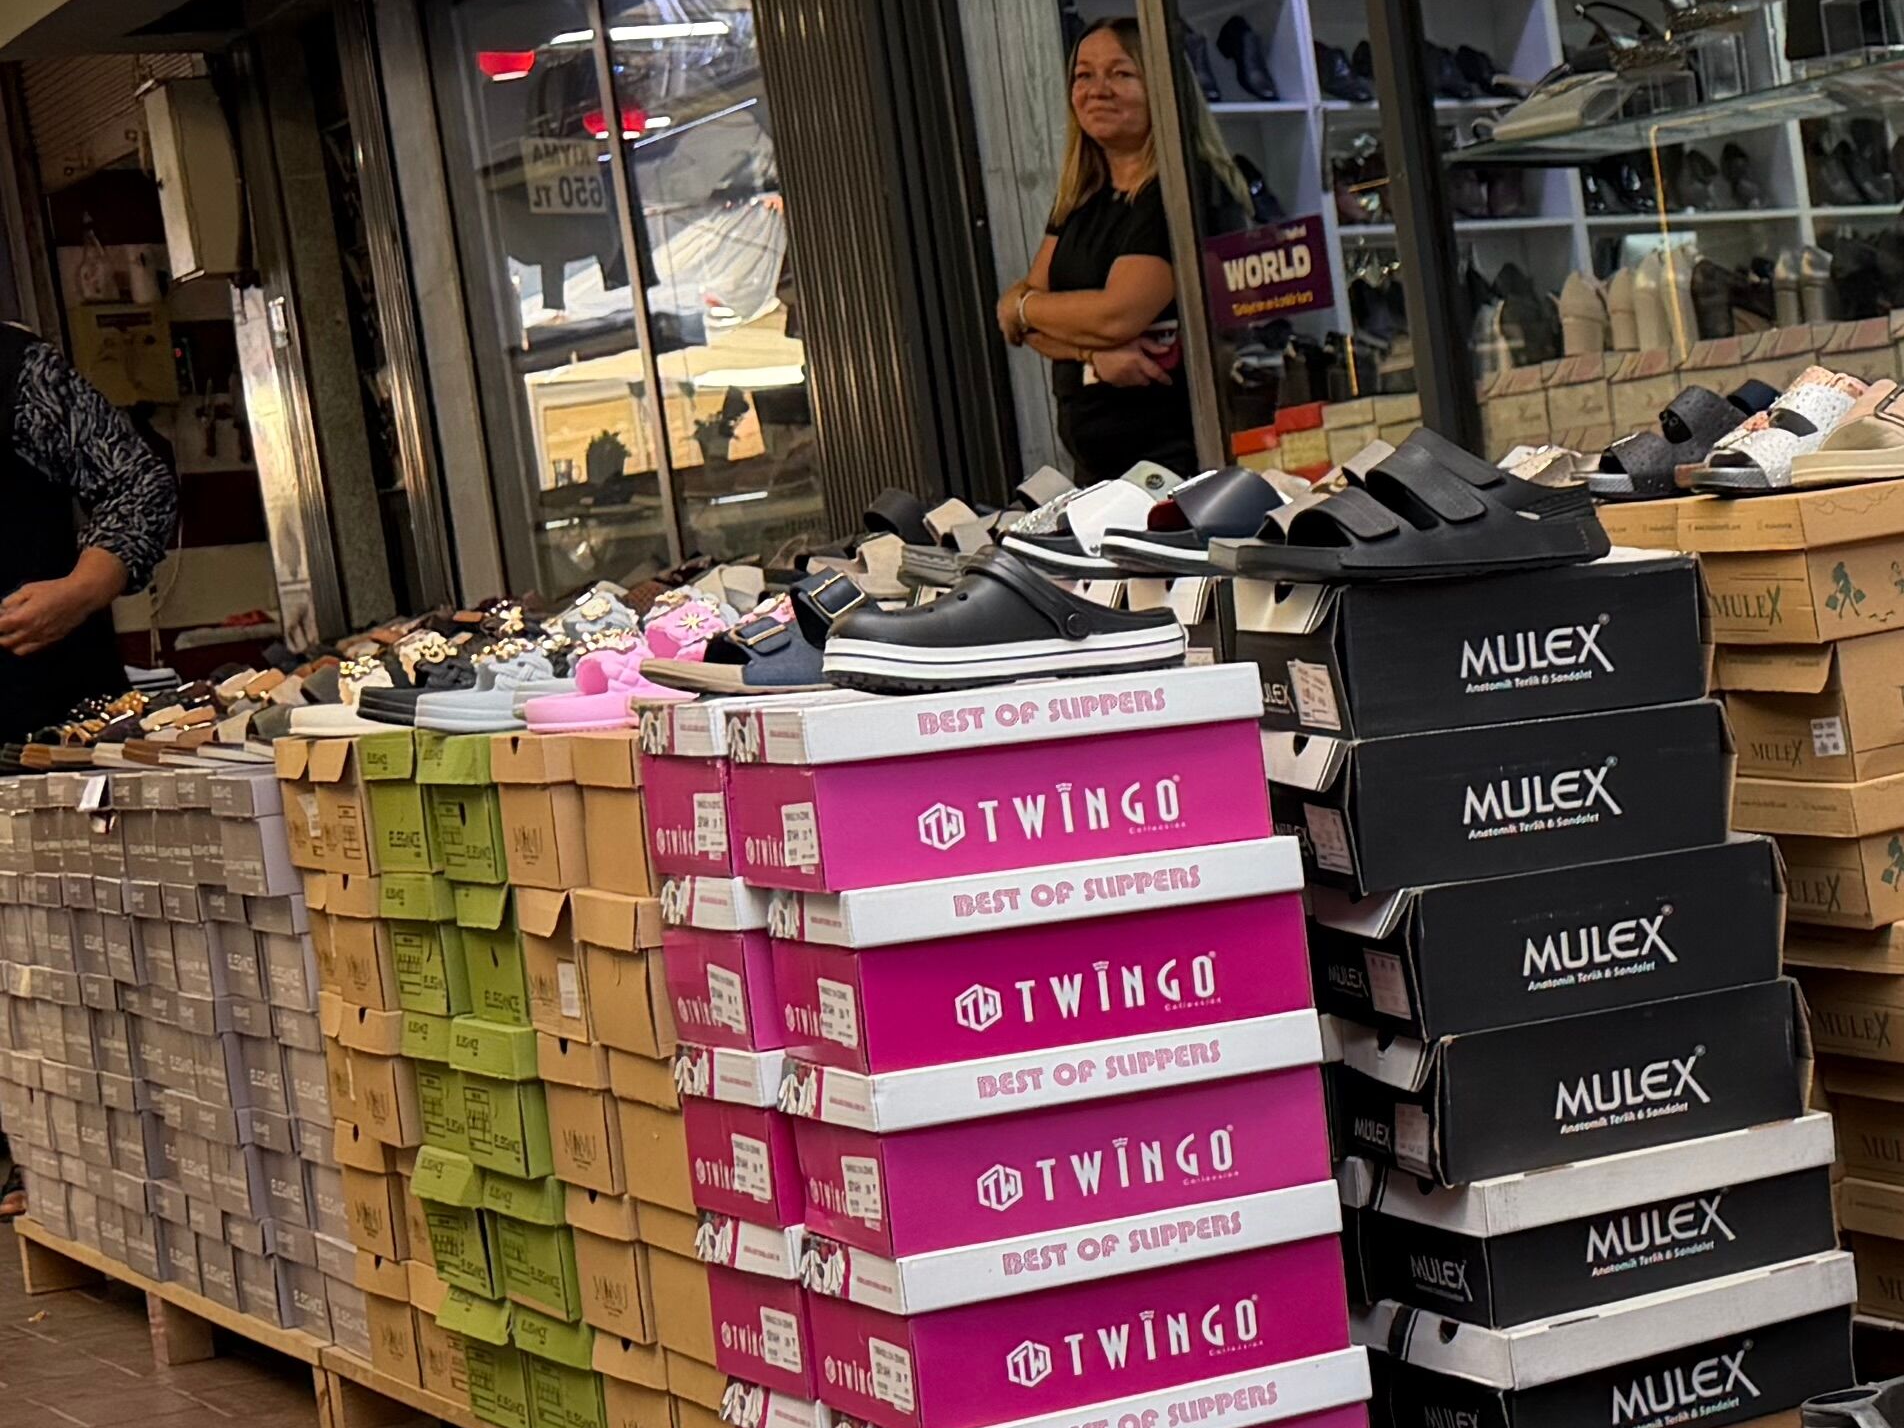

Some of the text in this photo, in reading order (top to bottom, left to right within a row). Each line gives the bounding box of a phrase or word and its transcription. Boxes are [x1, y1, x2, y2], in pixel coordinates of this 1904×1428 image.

[1223, 243, 1312, 292] WORLD
[1712, 585, 1783, 625] MULEX
[1460, 623, 1615, 679] MULEX
[918, 687, 1166, 736] BEST OF SLIPPERS
[1463, 766, 1624, 826] MULEX
[953, 865, 1202, 917] BEST OF SLIPPERS
[1788, 874, 1841, 914] ULEX
[1522, 914, 1679, 978] MULEX
[977, 1041, 1221, 1100] BEST OF SLIPPERS
[1554, 1055, 1712, 1121] MULEX
[1002, 1211, 1243, 1275] BEST OF SLIPPERS
[1586, 1194, 1737, 1264] MULEX
[1168, 1382, 1279, 1425] SLIPPERS
[1612, 1349, 1761, 1426] MULEX
